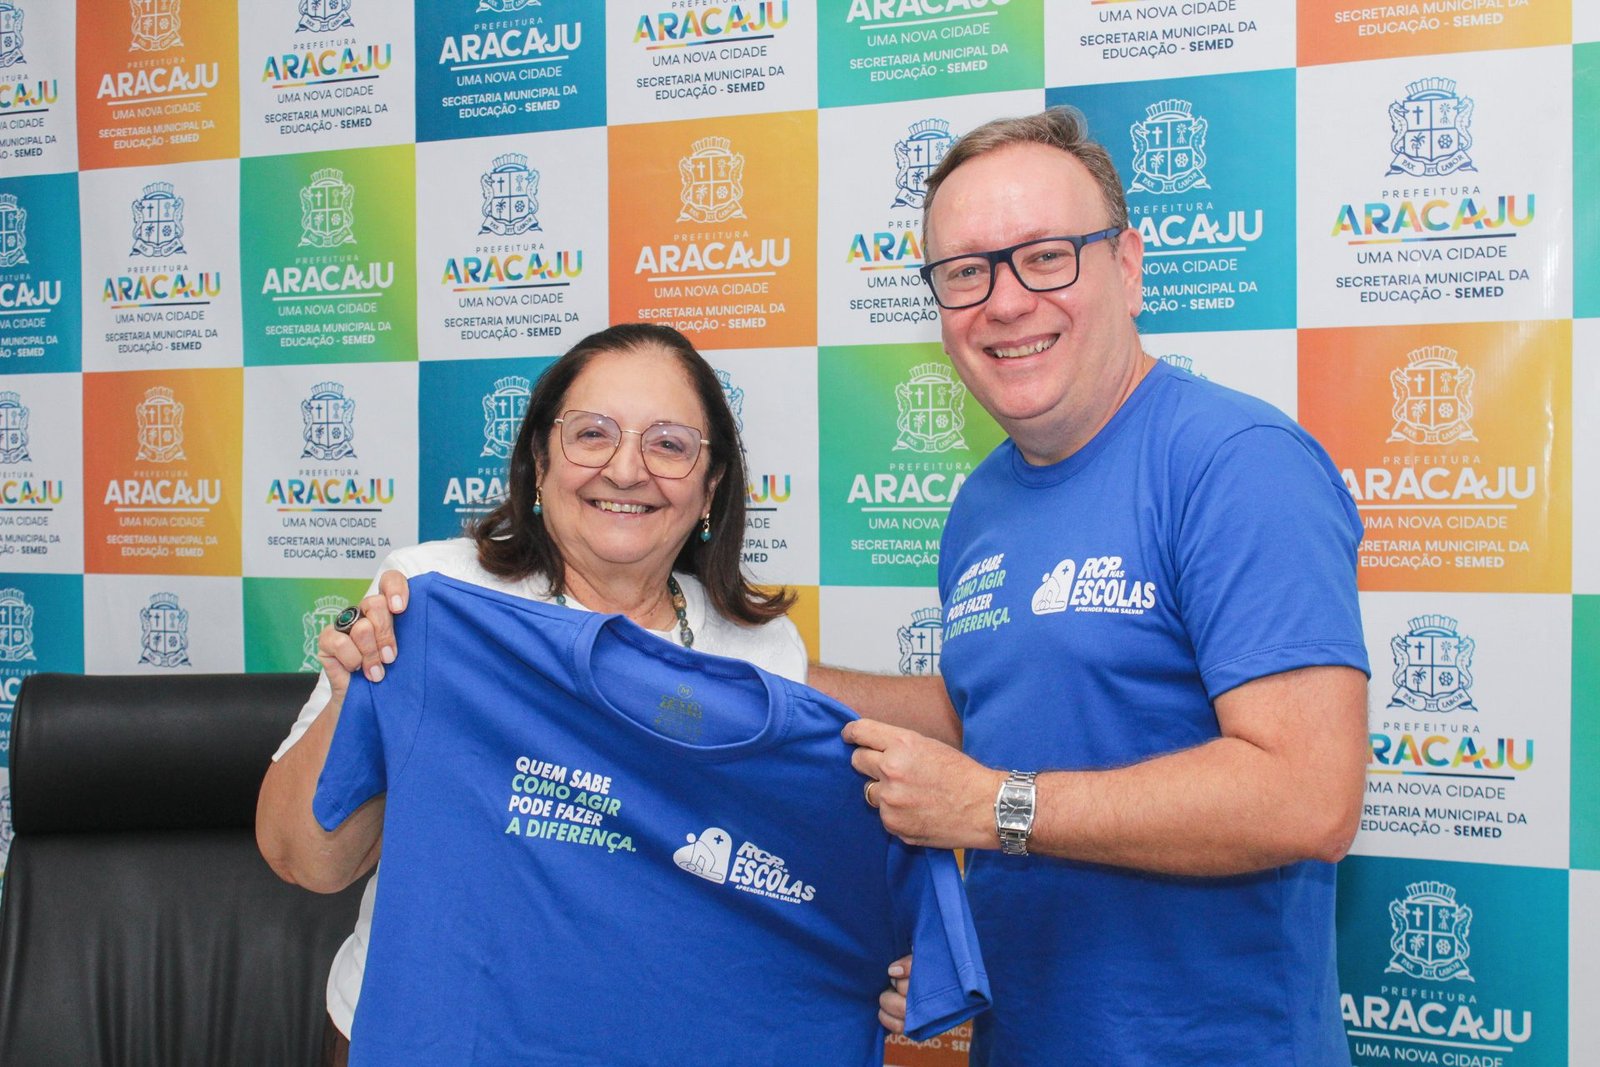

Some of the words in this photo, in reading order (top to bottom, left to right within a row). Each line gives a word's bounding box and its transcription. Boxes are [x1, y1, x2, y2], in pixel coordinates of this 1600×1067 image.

[1099, 9, 1132, 23] UMA
[1136, 5, 1178, 19] NOVA
[1181, 0, 1237, 16] CIDADE
[1333, 4, 1420, 23] SECRETARIA
[474, 17, 543, 31] PREFEITURA
[632, 0, 788, 44] ARACAJU
[1358, 16, 1440, 36] EDUCAÇÃO
[1453, 13, 1503, 27] SEMED
[867, 33, 897, 47] UMA
[900, 29, 938, 43] NOVA
[941, 23, 990, 39] CIDADE
[1080, 29, 1159, 47] SECRETARIA
[1161, 22, 1234, 40] MUNICIPAL
[1238, 20, 1257, 33] DA
[437, 22, 582, 65] ARACAJU
[1102, 41, 1177, 60] EDUCAÇÃO
[1188, 38, 1234, 52] SEMED
[260, 43, 392, 83] ARACAJU
[652, 54, 680, 67] UMA
[683, 50, 718, 64] NOVA
[721, 45, 767, 60] CIDADE
[850, 52, 920, 70] SECRETARIA
[923, 45, 988, 62] MUNICIPAL
[456, 74, 482, 86] UMA
[484, 71, 517, 83] NOVA
[519, 66, 562, 80] CIDADE
[636, 72, 702, 89] SECRETARIA
[704, 67, 765, 82] MUNICIPAL
[768, 65, 784, 76] DA
[870, 64, 937, 82] EDUCAÇÃO
[947, 60, 988, 73] SEMED
[277, 92, 301, 104] UMA
[303, 89, 333, 101] NOVA
[335, 85, 374, 98] CIDADE
[441, 92, 502, 107] SECRETARIA
[504, 86, 560, 101] MUNICIPAL
[655, 84, 718, 100] EDUCAÇÃO
[727, 81, 765, 93] SEMED
[458, 102, 516, 119] EDUCAÇÃO
[525, 100, 560, 112] SEMED
[340, 117, 372, 129] SEMED
[1382, 185, 1480, 199] PREFEITURA
[1330, 193, 1536, 237] ARACAJU
[634, 238, 791, 275] ARACAJU
[1357, 251, 1393, 264] UMA
[1397, 249, 1442, 262] NOVA
[1447, 245, 1507, 260] CIDADE
[439, 250, 583, 285] ARACAJU
[1183, 259, 1238, 273] CIDADE
[261, 261, 395, 294] ARACAJU
[867, 276, 898, 288] UMA
[1335, 273, 1422, 288] SECRETARIA
[1424, 270, 1505, 285] MUNICIPAL
[1509, 269, 1529, 281] DA
[0, 280, 61, 310] CAJU
[654, 287, 682, 298] UMA
[685, 285, 720, 297] NOVA
[722, 282, 769, 295] CIDADE
[1163, 282, 1235, 296] MUNICIPAL
[1360, 287, 1442, 304] EDUCAÇÃO
[1454, 286, 1504, 299] SEMED
[278, 306, 302, 316] UMA
[304, 304, 334, 315] NOVA
[337, 302, 376, 314] CIDADE
[458, 297, 484, 308] UMA
[486, 295, 518, 307] NOVA
[521, 293, 563, 305] CIDADE
[849, 297, 921, 310] SECRETARIA
[1190, 297, 1235, 309] SEMED
[443, 315, 504, 328] SECRETARIA
[505, 313, 562, 325] MUNICIPAL
[637, 306, 703, 319] SECRETARIA
[705, 303, 766, 316] MUNICIPAL
[869, 309, 938, 325] EDUCAÇÃO
[728, 318, 766, 328] SEMED
[342, 335, 375, 344] SEMED
[460, 326, 518, 341] EDUCAÇÃO
[526, 326, 562, 337] SEMED
[889, 462, 971, 471] PREFEITURA
[1383, 455, 1481, 465] PREFEITURA
[0, 480, 63, 505] CAJU
[266, 478, 394, 505] ARACAJU
[283, 517, 306, 527] UMA
[308, 518, 337, 528] NOVA
[339, 518, 377, 528] CIDADE
[868, 518, 899, 529] UMA
[902, 518, 940, 529] NOVA
[1398, 516, 1443, 529] NOVA
[1447, 516, 1507, 529] CIDADE
[268, 536, 325, 546] SECRETARIA
[326, 536, 376, 547] MUNICIPAL
[851, 539, 923, 550] SECRETARIA
[1425, 540, 1504, 552] MUNICIPAL
[1509, 540, 1529, 552] DA
[283, 547, 337, 561] EDUCAÇÃO
[344, 550, 376, 559] SEMED
[871, 552, 940, 567] EDUCAÇÃO
[1360, 554, 1442, 570] EDUCAÇÃO
[1454, 556, 1504, 567] SEMED
[1078, 556, 1122, 578] RCP
[977, 570, 1006, 592] AGIR
[965, 593, 992, 614] FAZER
[1069, 579, 1156, 609] ESCOLAS
[950, 607, 1010, 639] DIFERENÇA.
[1383, 721, 1480, 734] PREFEITURA
[516, 756, 567, 783] QUEM
[569, 770, 612, 794] SABE
[512, 774, 570, 800] COMO
[574, 792, 621, 816] AGIR
[1397, 782, 1442, 797] NOVA
[1446, 785, 1506, 800] CIDADE
[508, 795, 553, 817] PODE
[555, 802, 603, 826] FAZER
[1424, 807, 1503, 823] MUNICIPAL
[1507, 812, 1527, 824] DA
[505, 817, 520, 835] A
[526, 819, 636, 853] DIFERENÇA.
[1360, 819, 1441, 837] EDUCAÇÃO
[1453, 825, 1503, 838] SEMED
[729, 856, 816, 901] ESCOLAS
[1381, 985, 1477, 1004] PREFEITURA
[1340, 993, 1531, 1044] ARACAJU
[1355, 1043, 1391, 1059] UMA
[1395, 1047, 1439, 1064] NOVA
